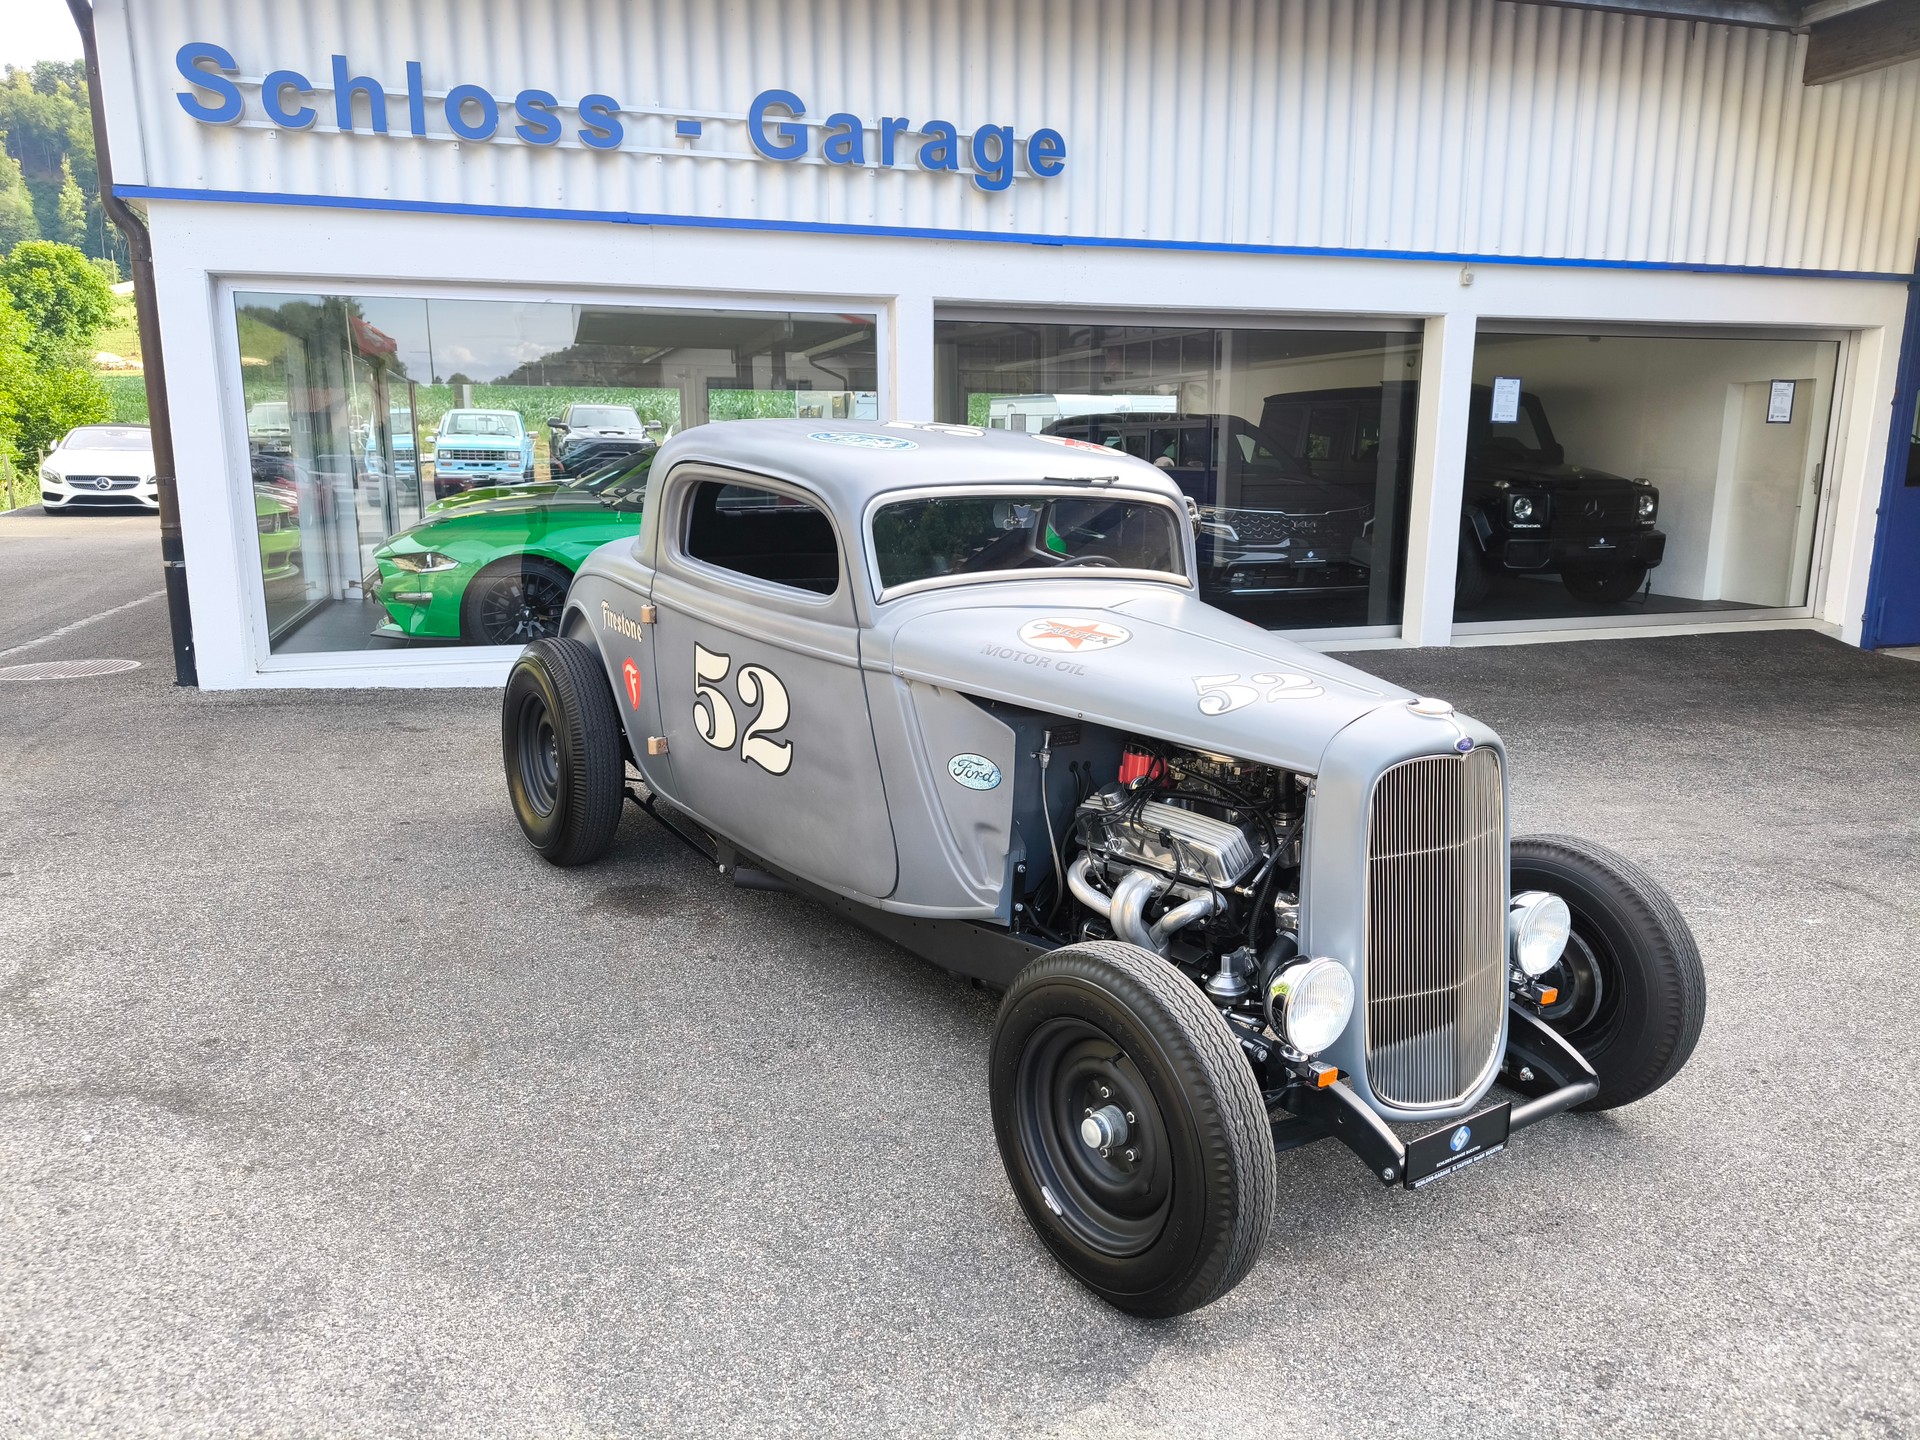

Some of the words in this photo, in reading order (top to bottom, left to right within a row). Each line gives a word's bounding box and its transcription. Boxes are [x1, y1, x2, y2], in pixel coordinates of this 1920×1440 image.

[175, 41, 624, 150] Schloss
[747, 89, 1068, 192] Garage
[600, 600, 644, 643] Firestone
[1032, 622, 1117, 645] CALTEX
[979, 643, 1052, 669] MOTOR
[1054, 660, 1088, 677] OIL
[692, 640, 794, 776] 52
[1191, 671, 1326, 717] 52
[953, 759, 995, 783] Ford
